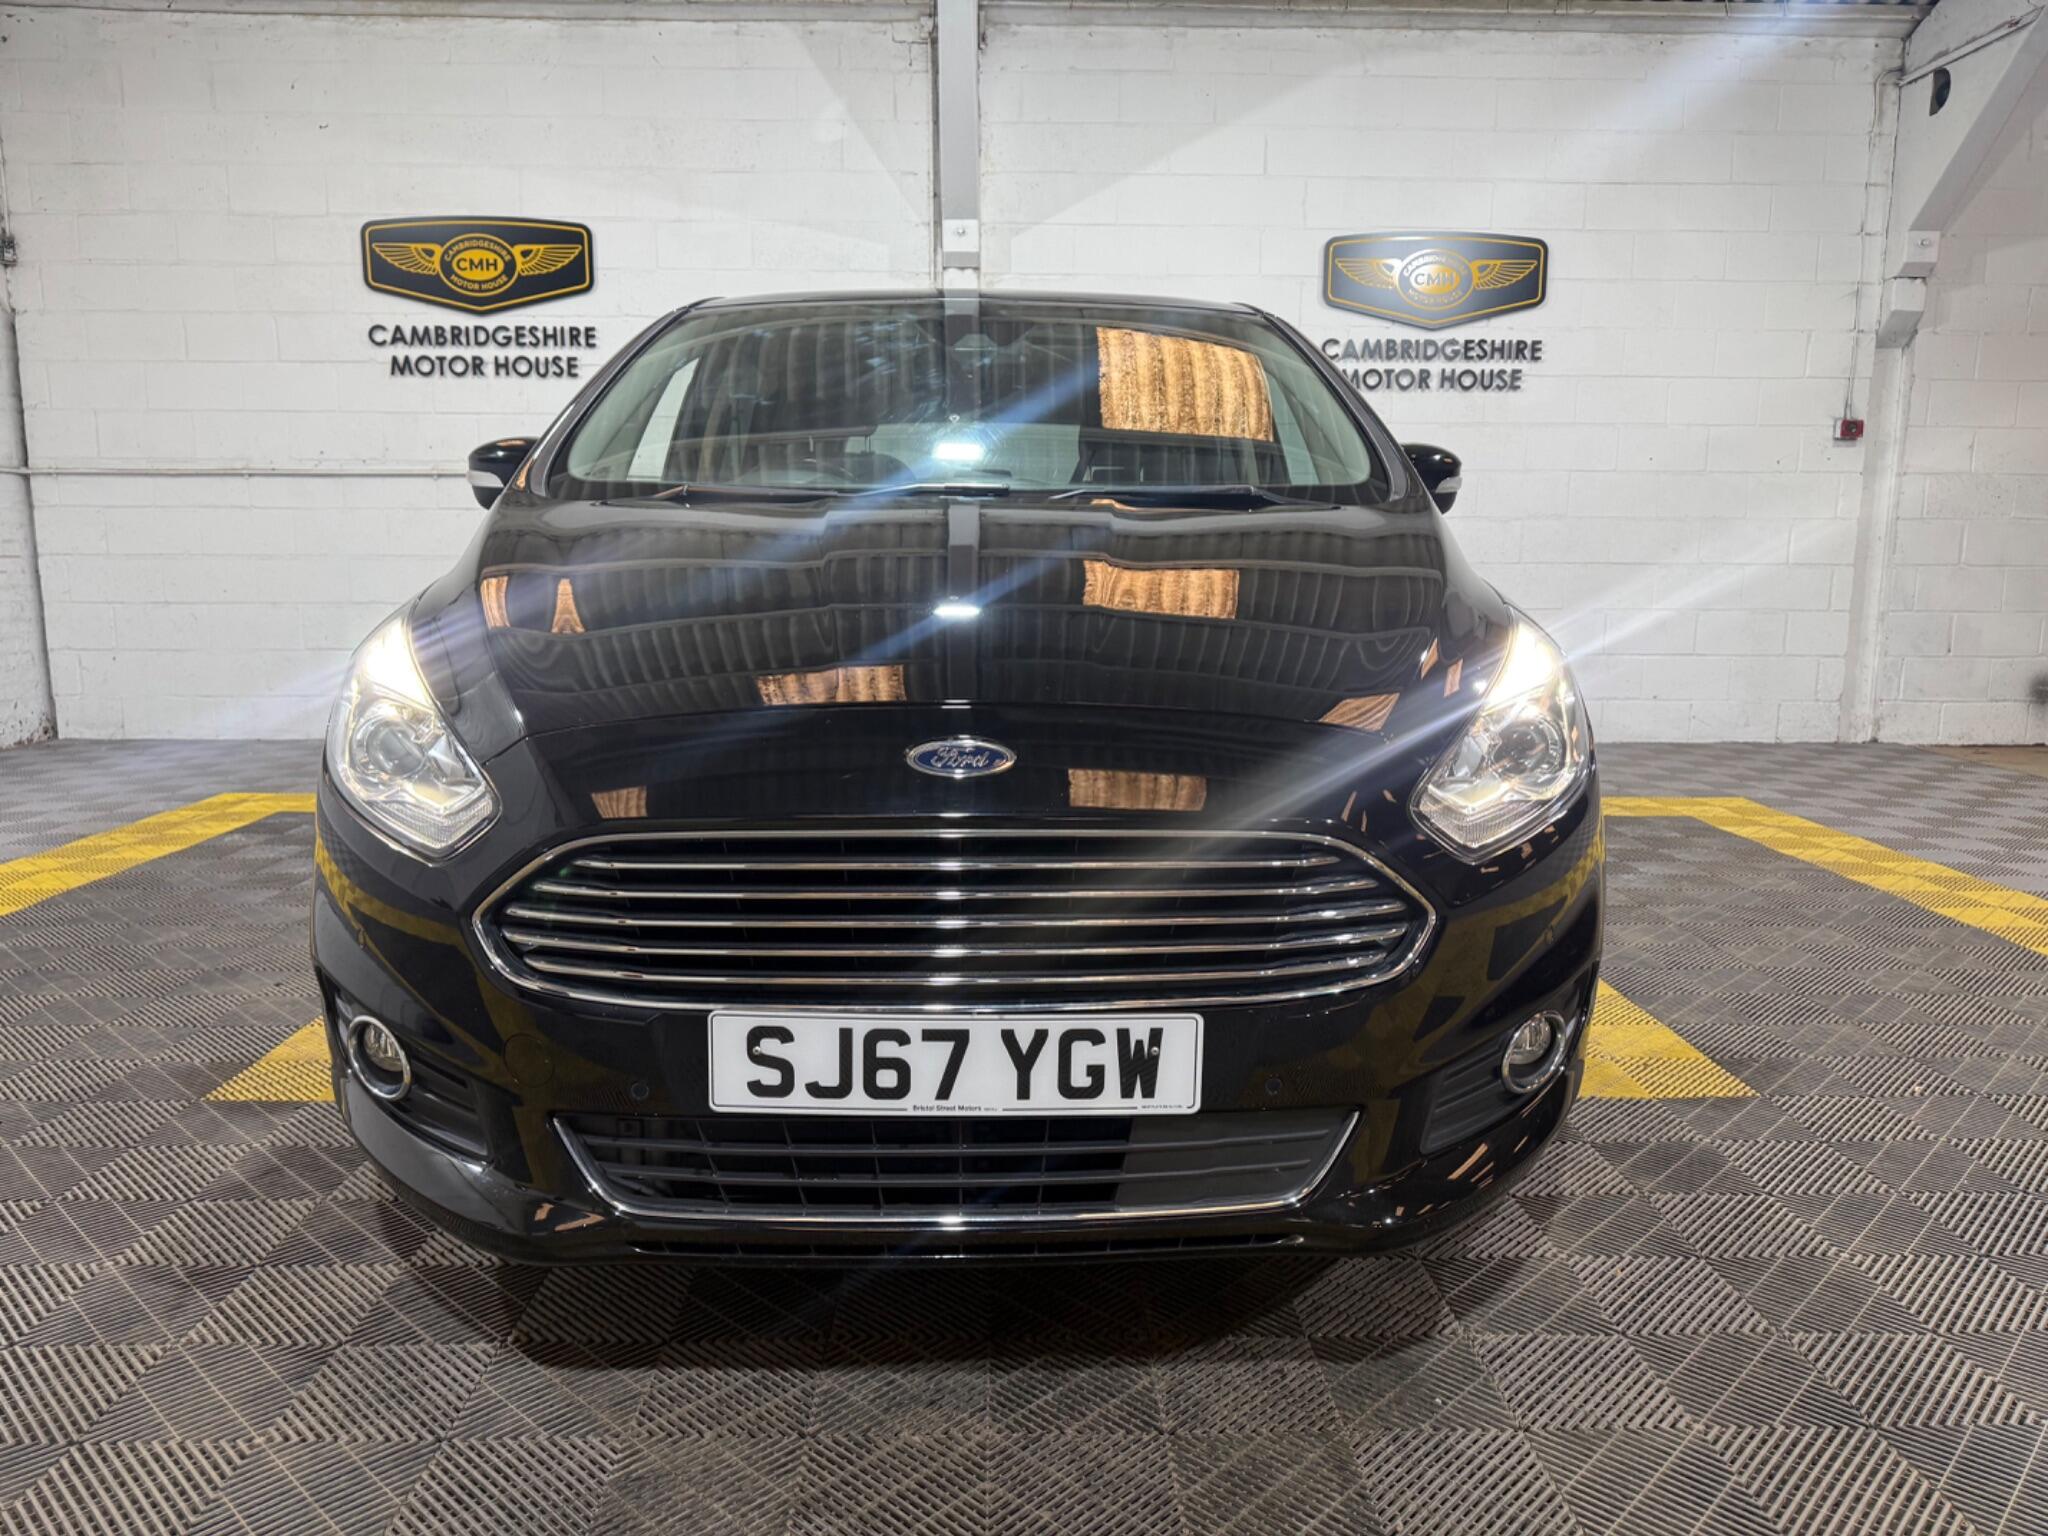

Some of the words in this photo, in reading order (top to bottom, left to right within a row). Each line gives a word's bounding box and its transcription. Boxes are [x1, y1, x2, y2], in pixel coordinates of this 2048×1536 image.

[444, 239, 511, 262] CAMBRIDGESHIRE
[456, 257, 498, 272] CMH
[450, 273, 480, 290] MOTOR
[481, 274, 508, 290] HOUSE
[368, 324, 597, 348] CAMBRIDGESHIRE
[1321, 338, 1543, 362] CAMBRIDGESHIRE
[391, 355, 486, 377] MOTOR
[494, 356, 579, 377] HOUSE
[1440, 368, 1523, 390] HOUSE
[930, 747, 990, 768] Ford
[745, 1025, 970, 1100] SJ67
[1000, 1027, 1163, 1100] YGW
[913, 1104, 935, 1112] Bristol
[936, 1104, 956, 1112] Street
[958, 1104, 982, 1112] Motors
